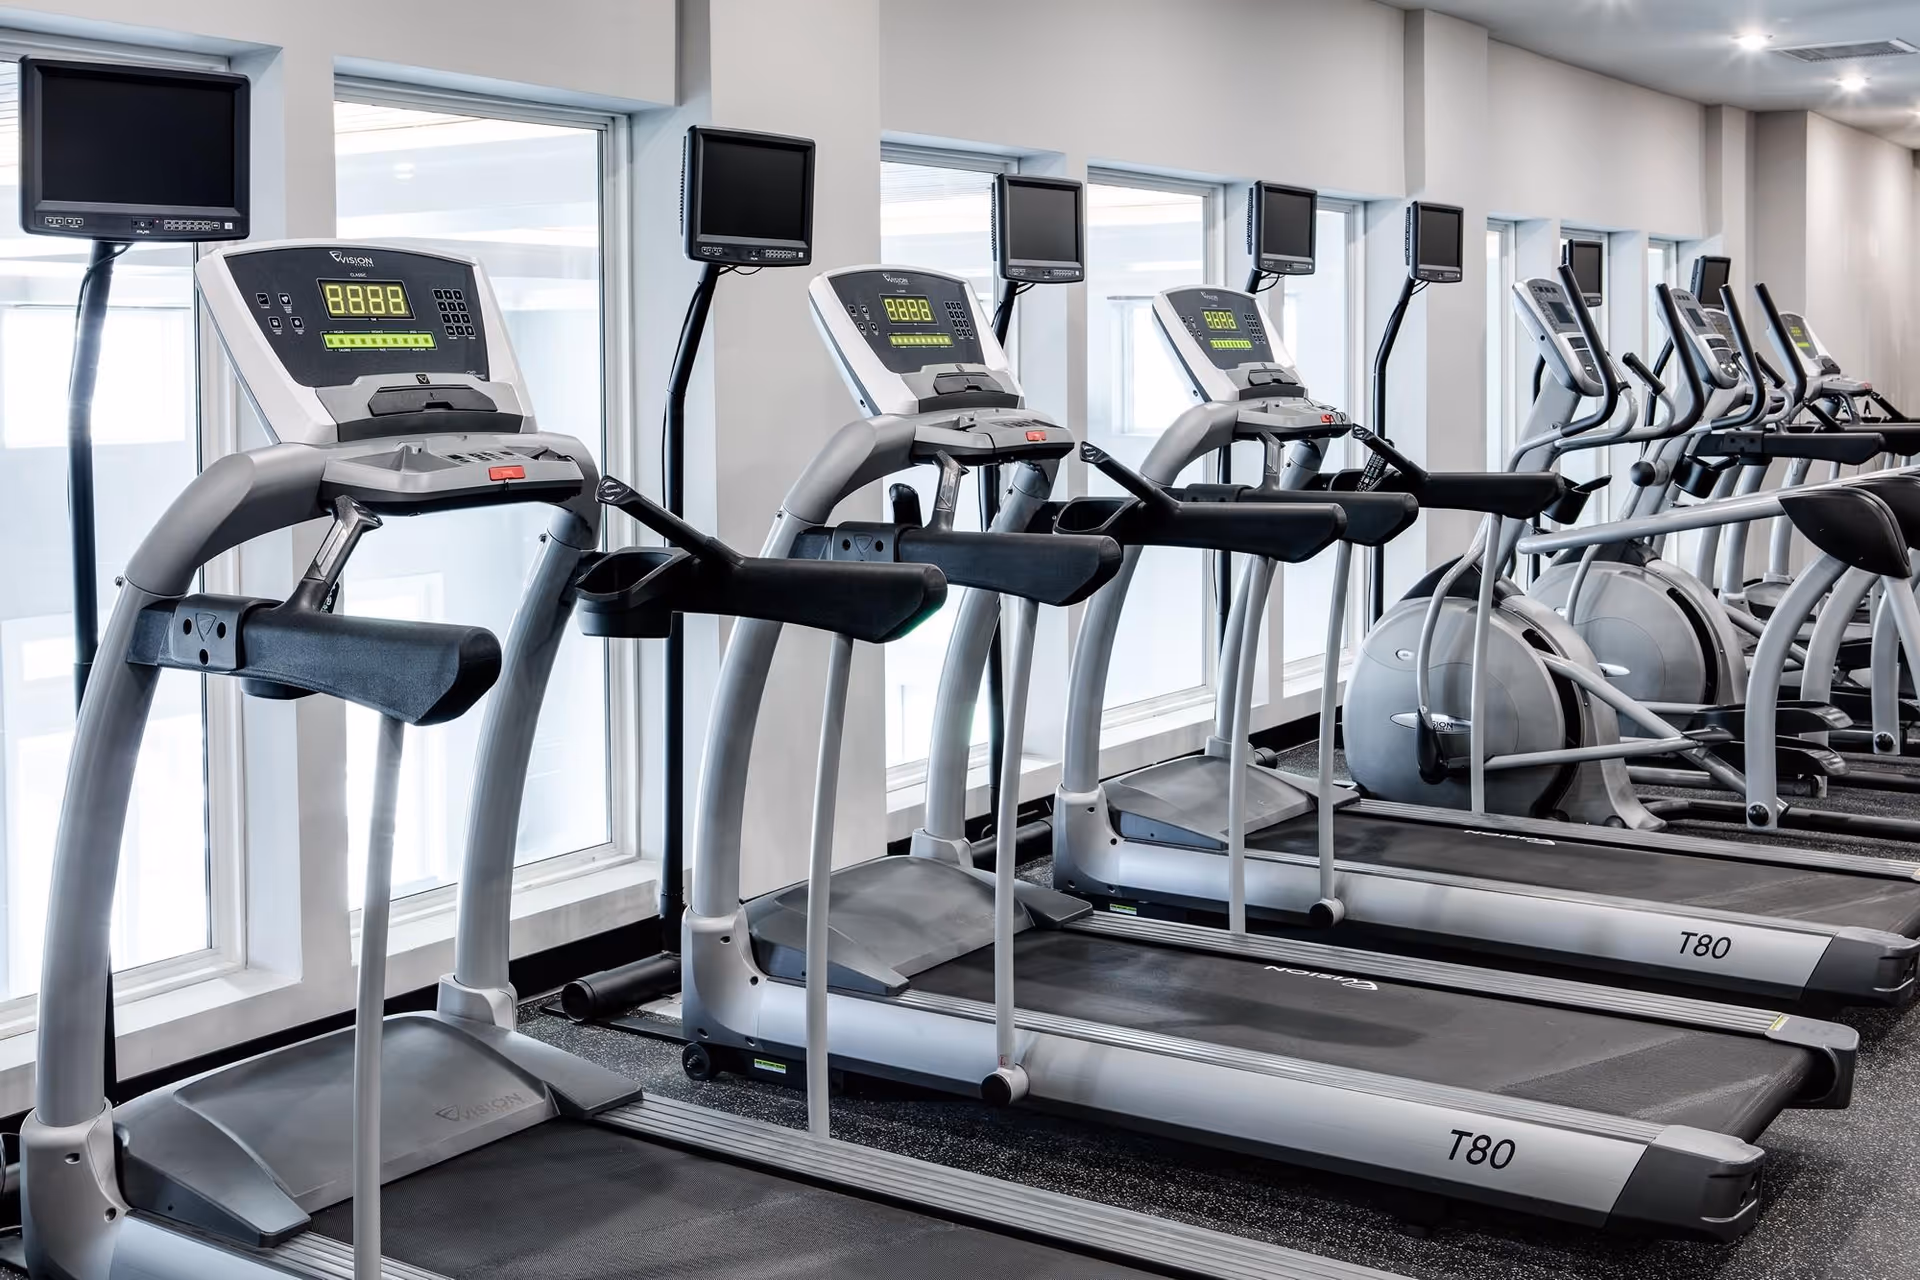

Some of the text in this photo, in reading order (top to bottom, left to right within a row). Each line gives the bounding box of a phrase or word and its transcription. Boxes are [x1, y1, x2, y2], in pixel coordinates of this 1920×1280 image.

[341, 256, 373, 265] VISION
[1679, 931, 1732, 959] T80
[1448, 1129, 1516, 1170] T80
